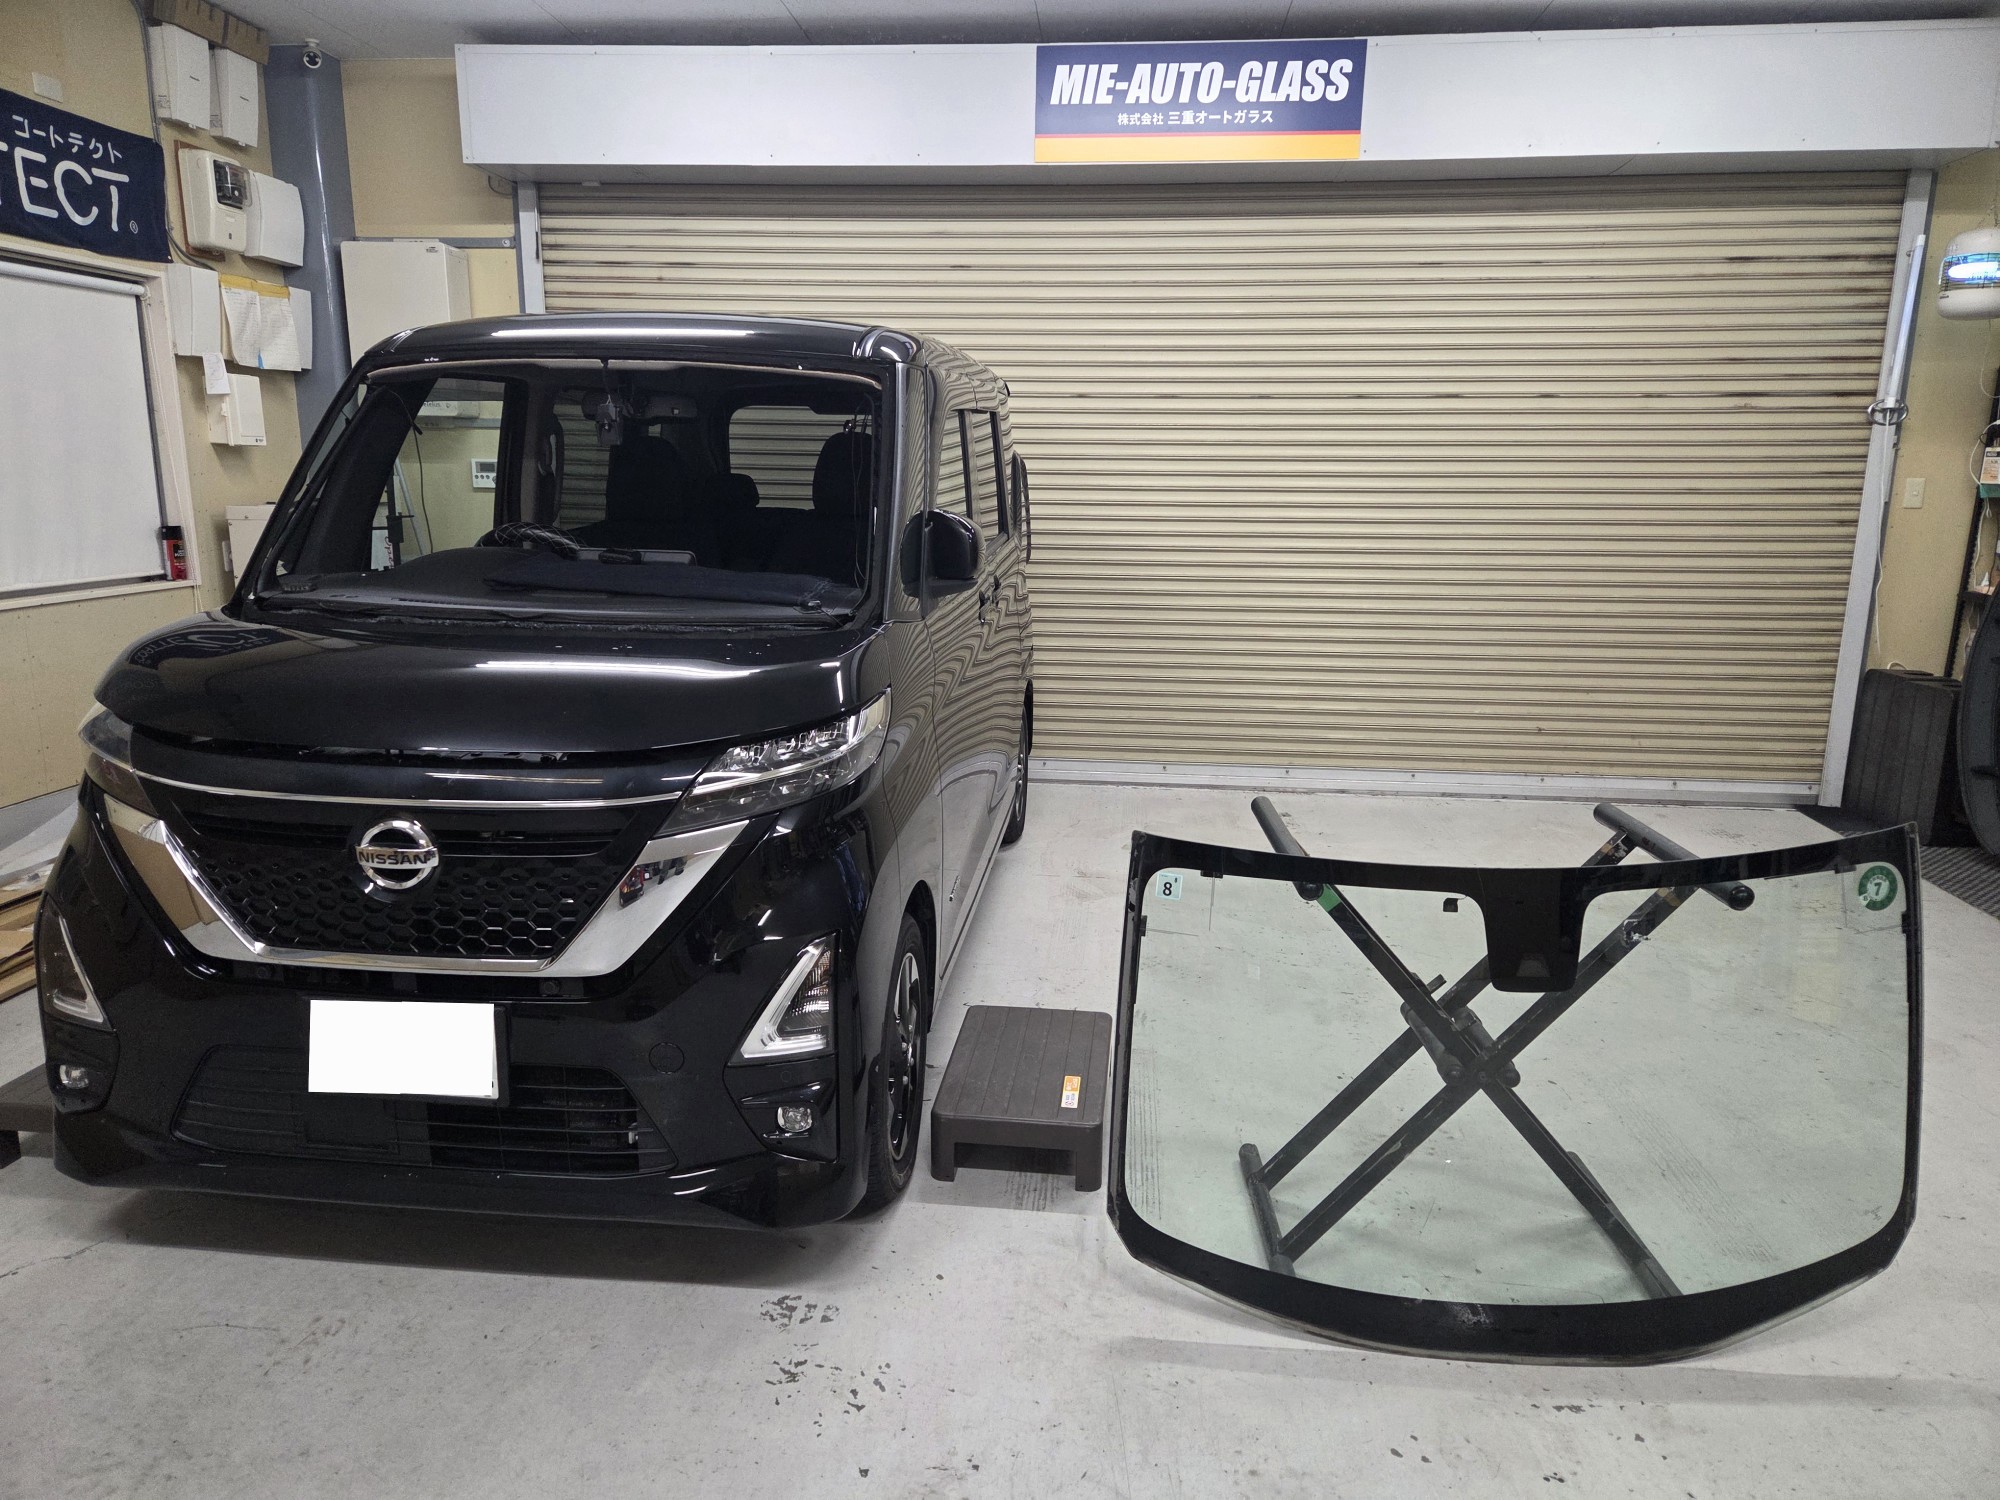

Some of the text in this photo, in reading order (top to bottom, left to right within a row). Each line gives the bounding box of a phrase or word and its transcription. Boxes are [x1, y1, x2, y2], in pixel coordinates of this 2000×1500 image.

[1050, 59, 1353, 105] MIE-AUTO-GLASS
[1117, 110, 1274, 125] 株式会社 三重オートガラス
[12, 115, 122, 163] コートテクト
[0, 141, 130, 232] ECT
[358, 851, 429, 865] NISSAN
[1163, 882, 1172, 896] 8
[1874, 882, 1882, 896] 7
